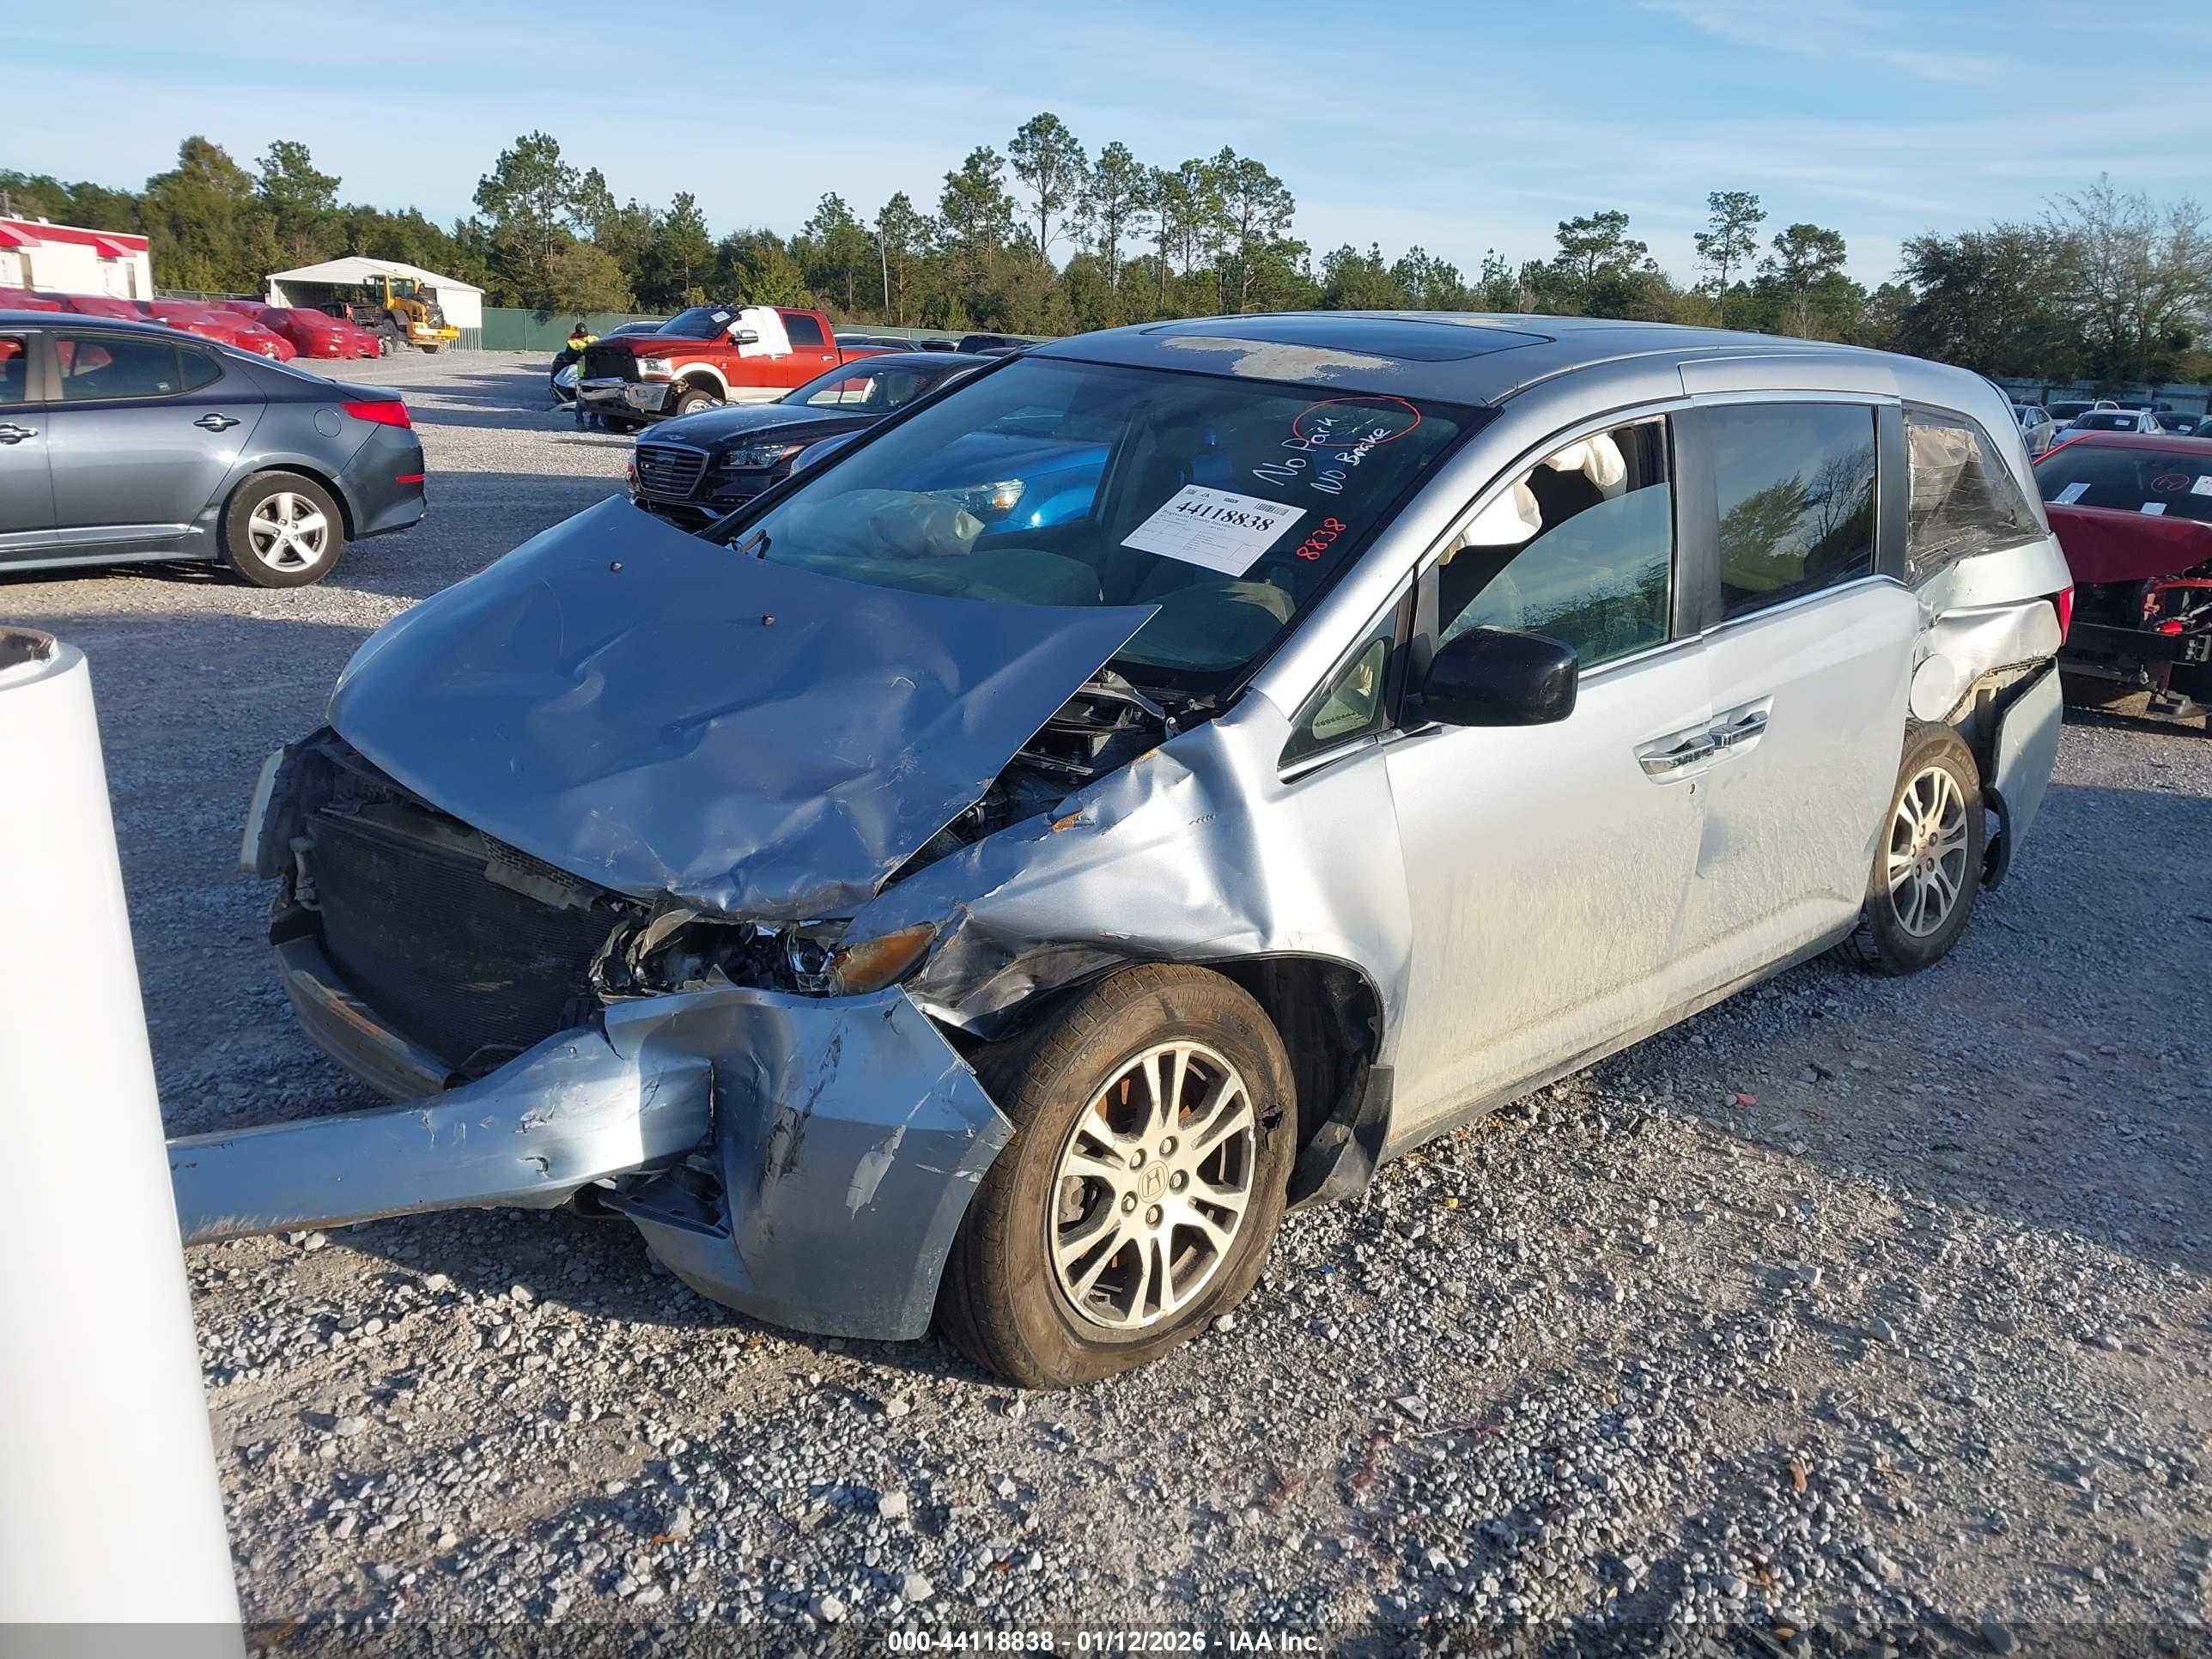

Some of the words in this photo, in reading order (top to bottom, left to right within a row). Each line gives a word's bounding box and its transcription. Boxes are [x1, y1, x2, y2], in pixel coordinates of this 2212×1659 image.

[1280, 416, 1340, 452] Park
[1176, 501, 1275, 532] 44118838
[1297, 518, 1346, 560] 8838
